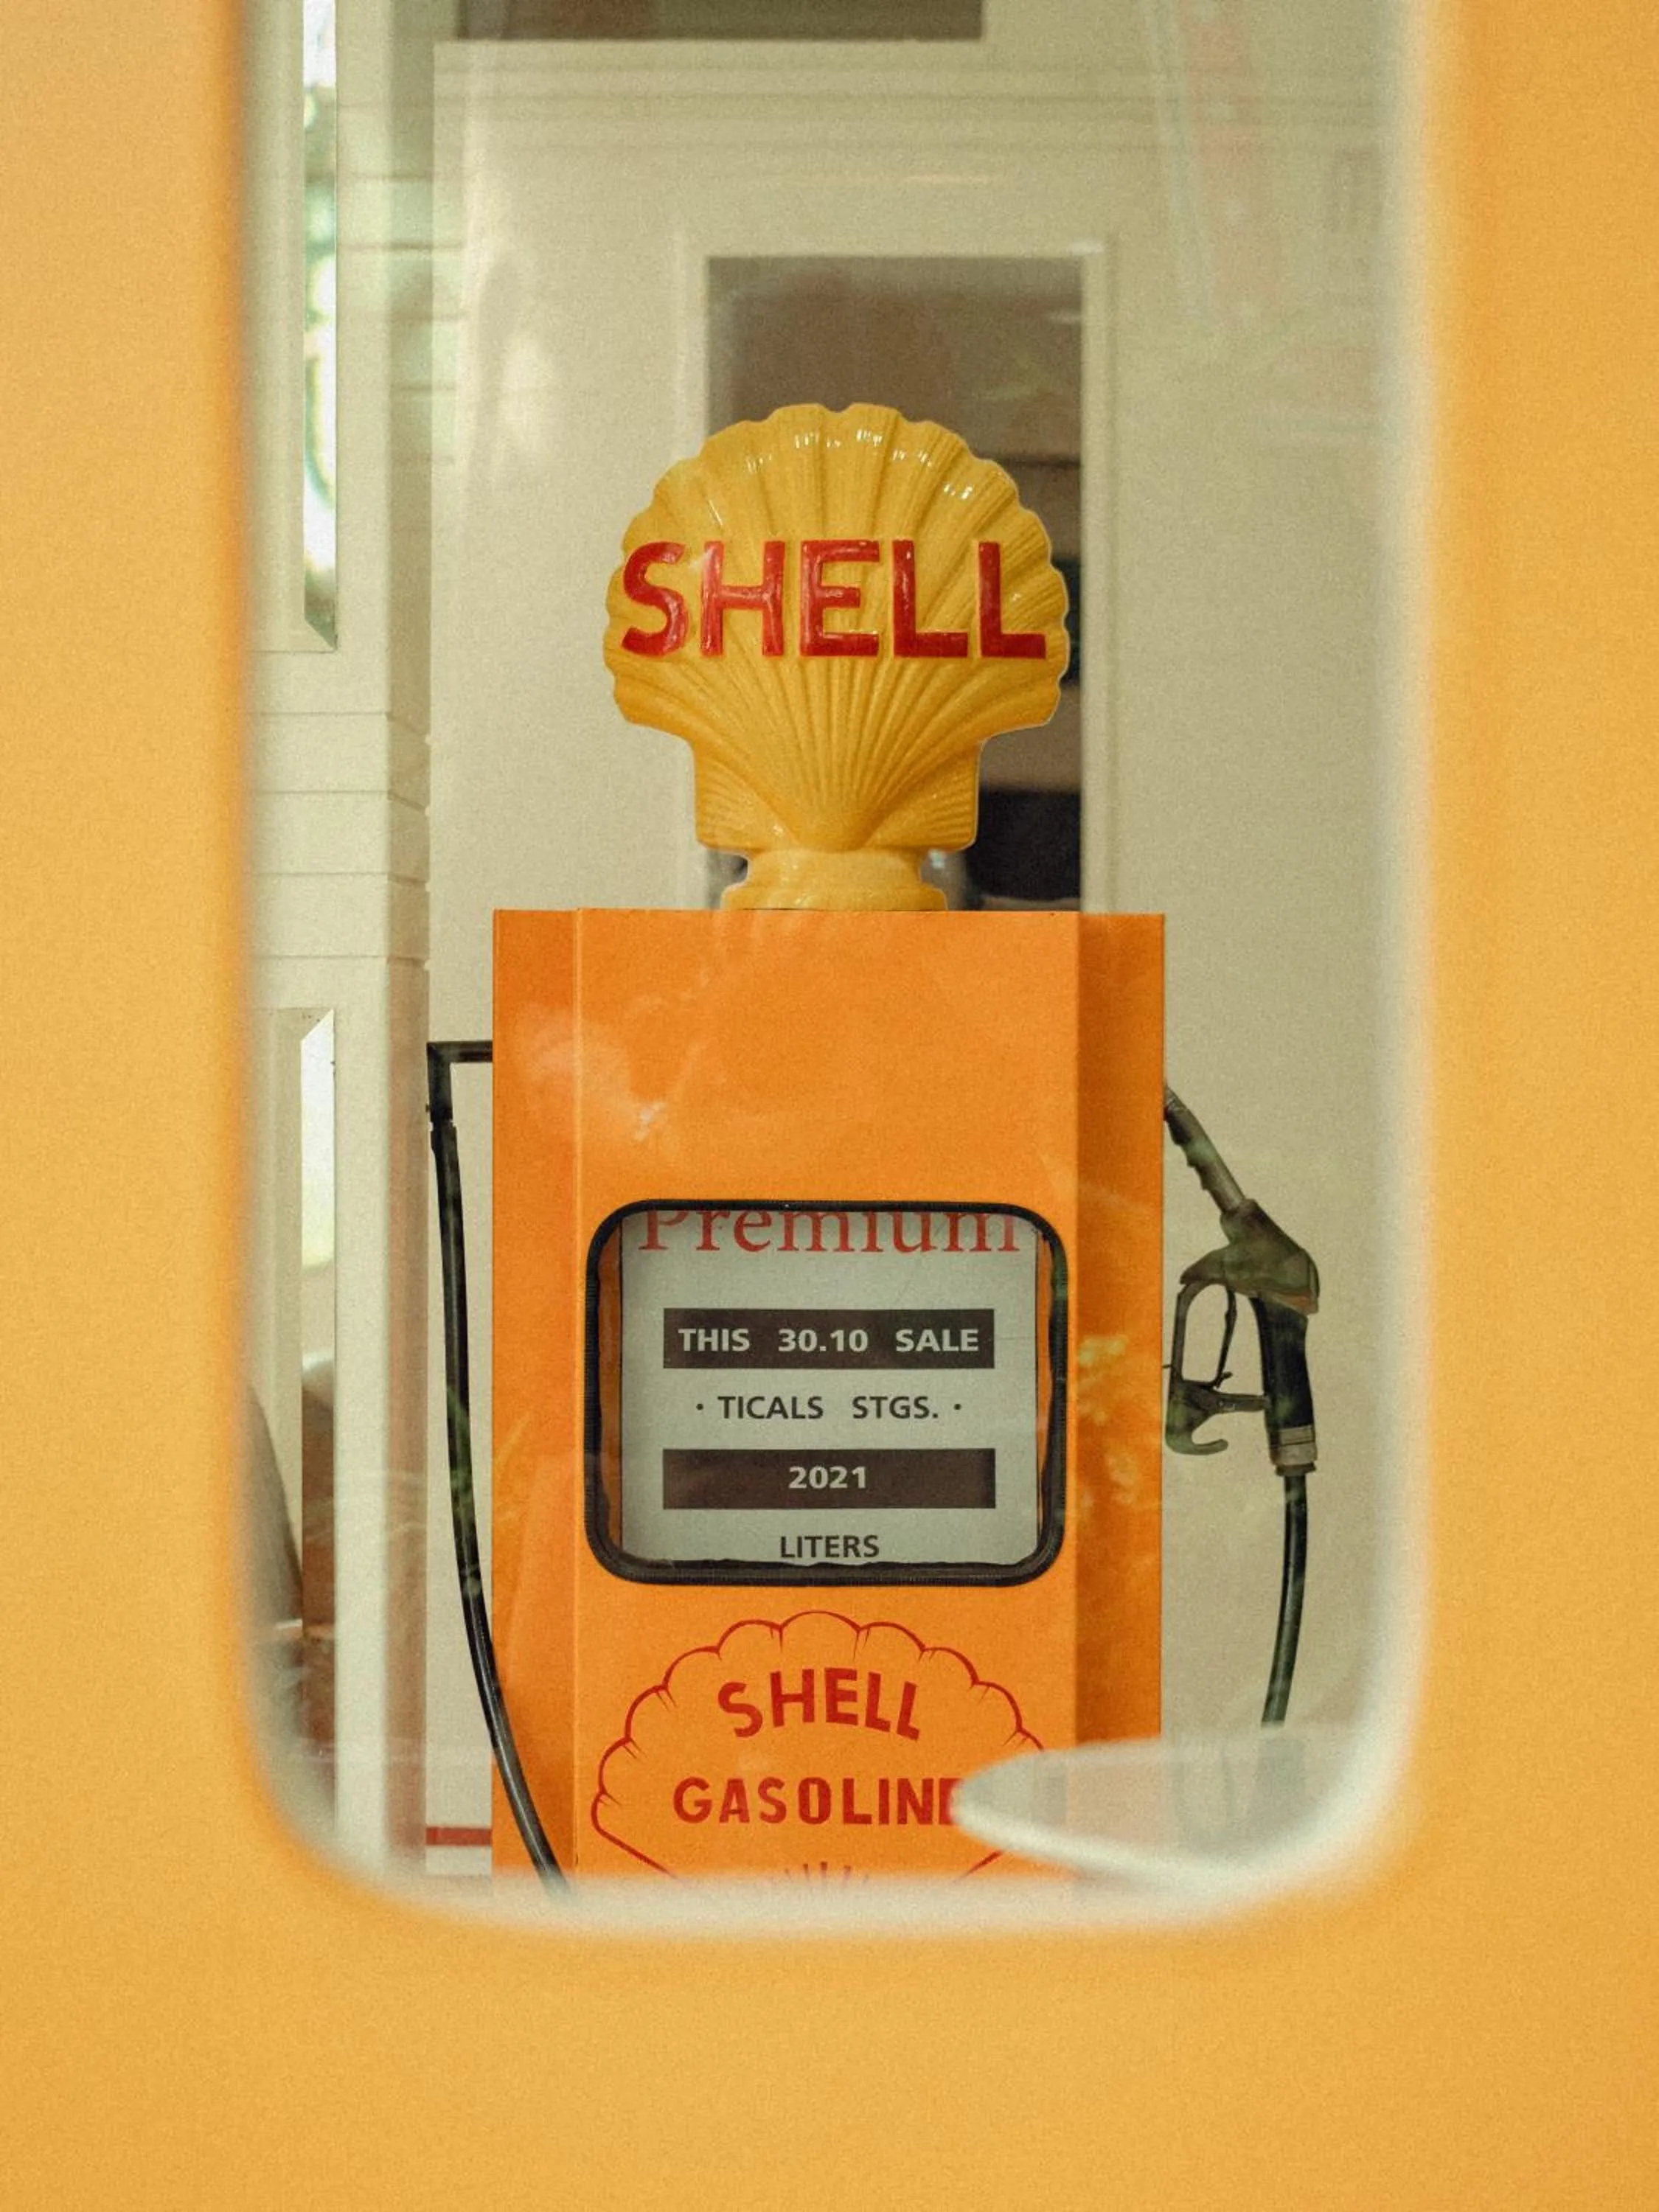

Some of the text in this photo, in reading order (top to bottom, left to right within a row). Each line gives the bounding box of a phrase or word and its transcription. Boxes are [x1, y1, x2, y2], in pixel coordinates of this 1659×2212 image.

[622, 540, 1046, 660] SHELL
[638, 1209, 1020, 1253] Premium
[678, 1328, 979, 1353] THIS 30.10 SALE
[717, 1396, 939, 1419] TICALS STGS.
[788, 1465, 867, 1490] 2021
[780, 1535, 880, 1558] LITERS
[717, 1667, 920, 1740] SHELL
